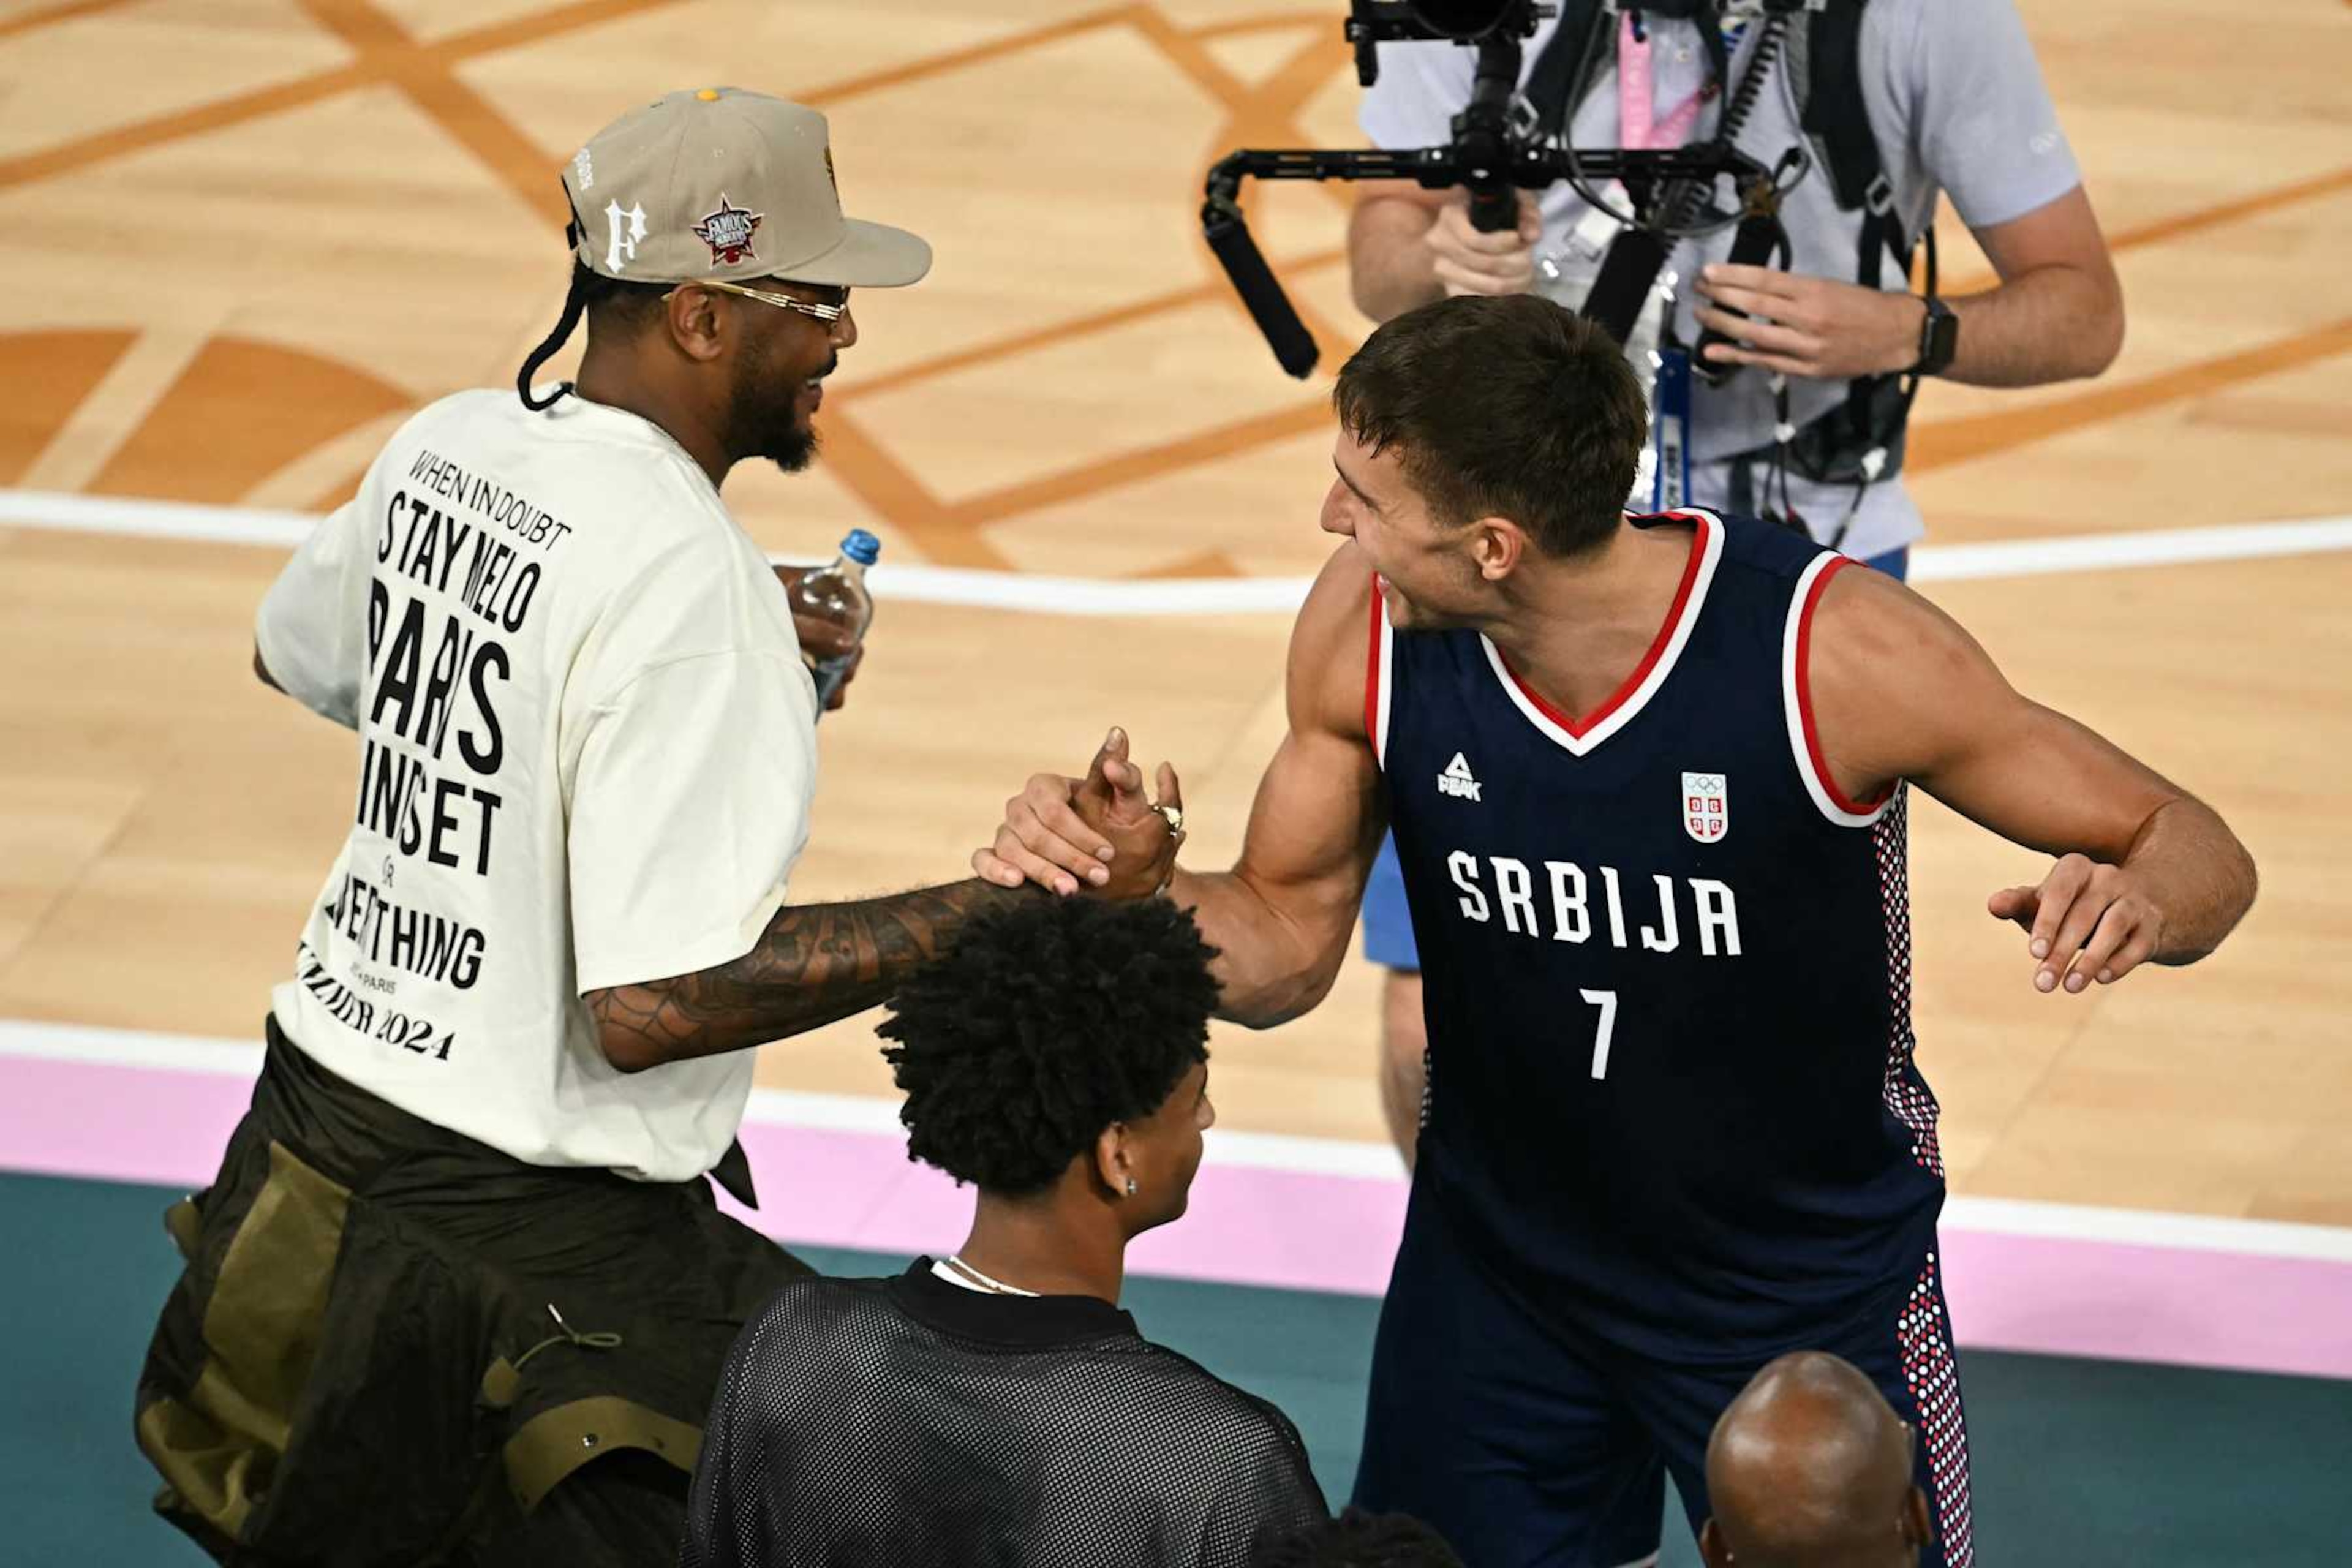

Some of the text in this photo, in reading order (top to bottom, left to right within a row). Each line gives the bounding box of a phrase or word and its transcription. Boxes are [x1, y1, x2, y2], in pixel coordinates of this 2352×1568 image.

[377, 491, 471, 593] STAY
[409, 450, 572, 551] WHEN IN DOUBT
[369, 575, 511, 776] PARIS
[1436, 773, 1482, 802] PEAK
[1447, 850, 1742, 956] SRBIJA
[375, 1008, 456, 1061] 2024
[1578, 987, 1618, 1080] 7
